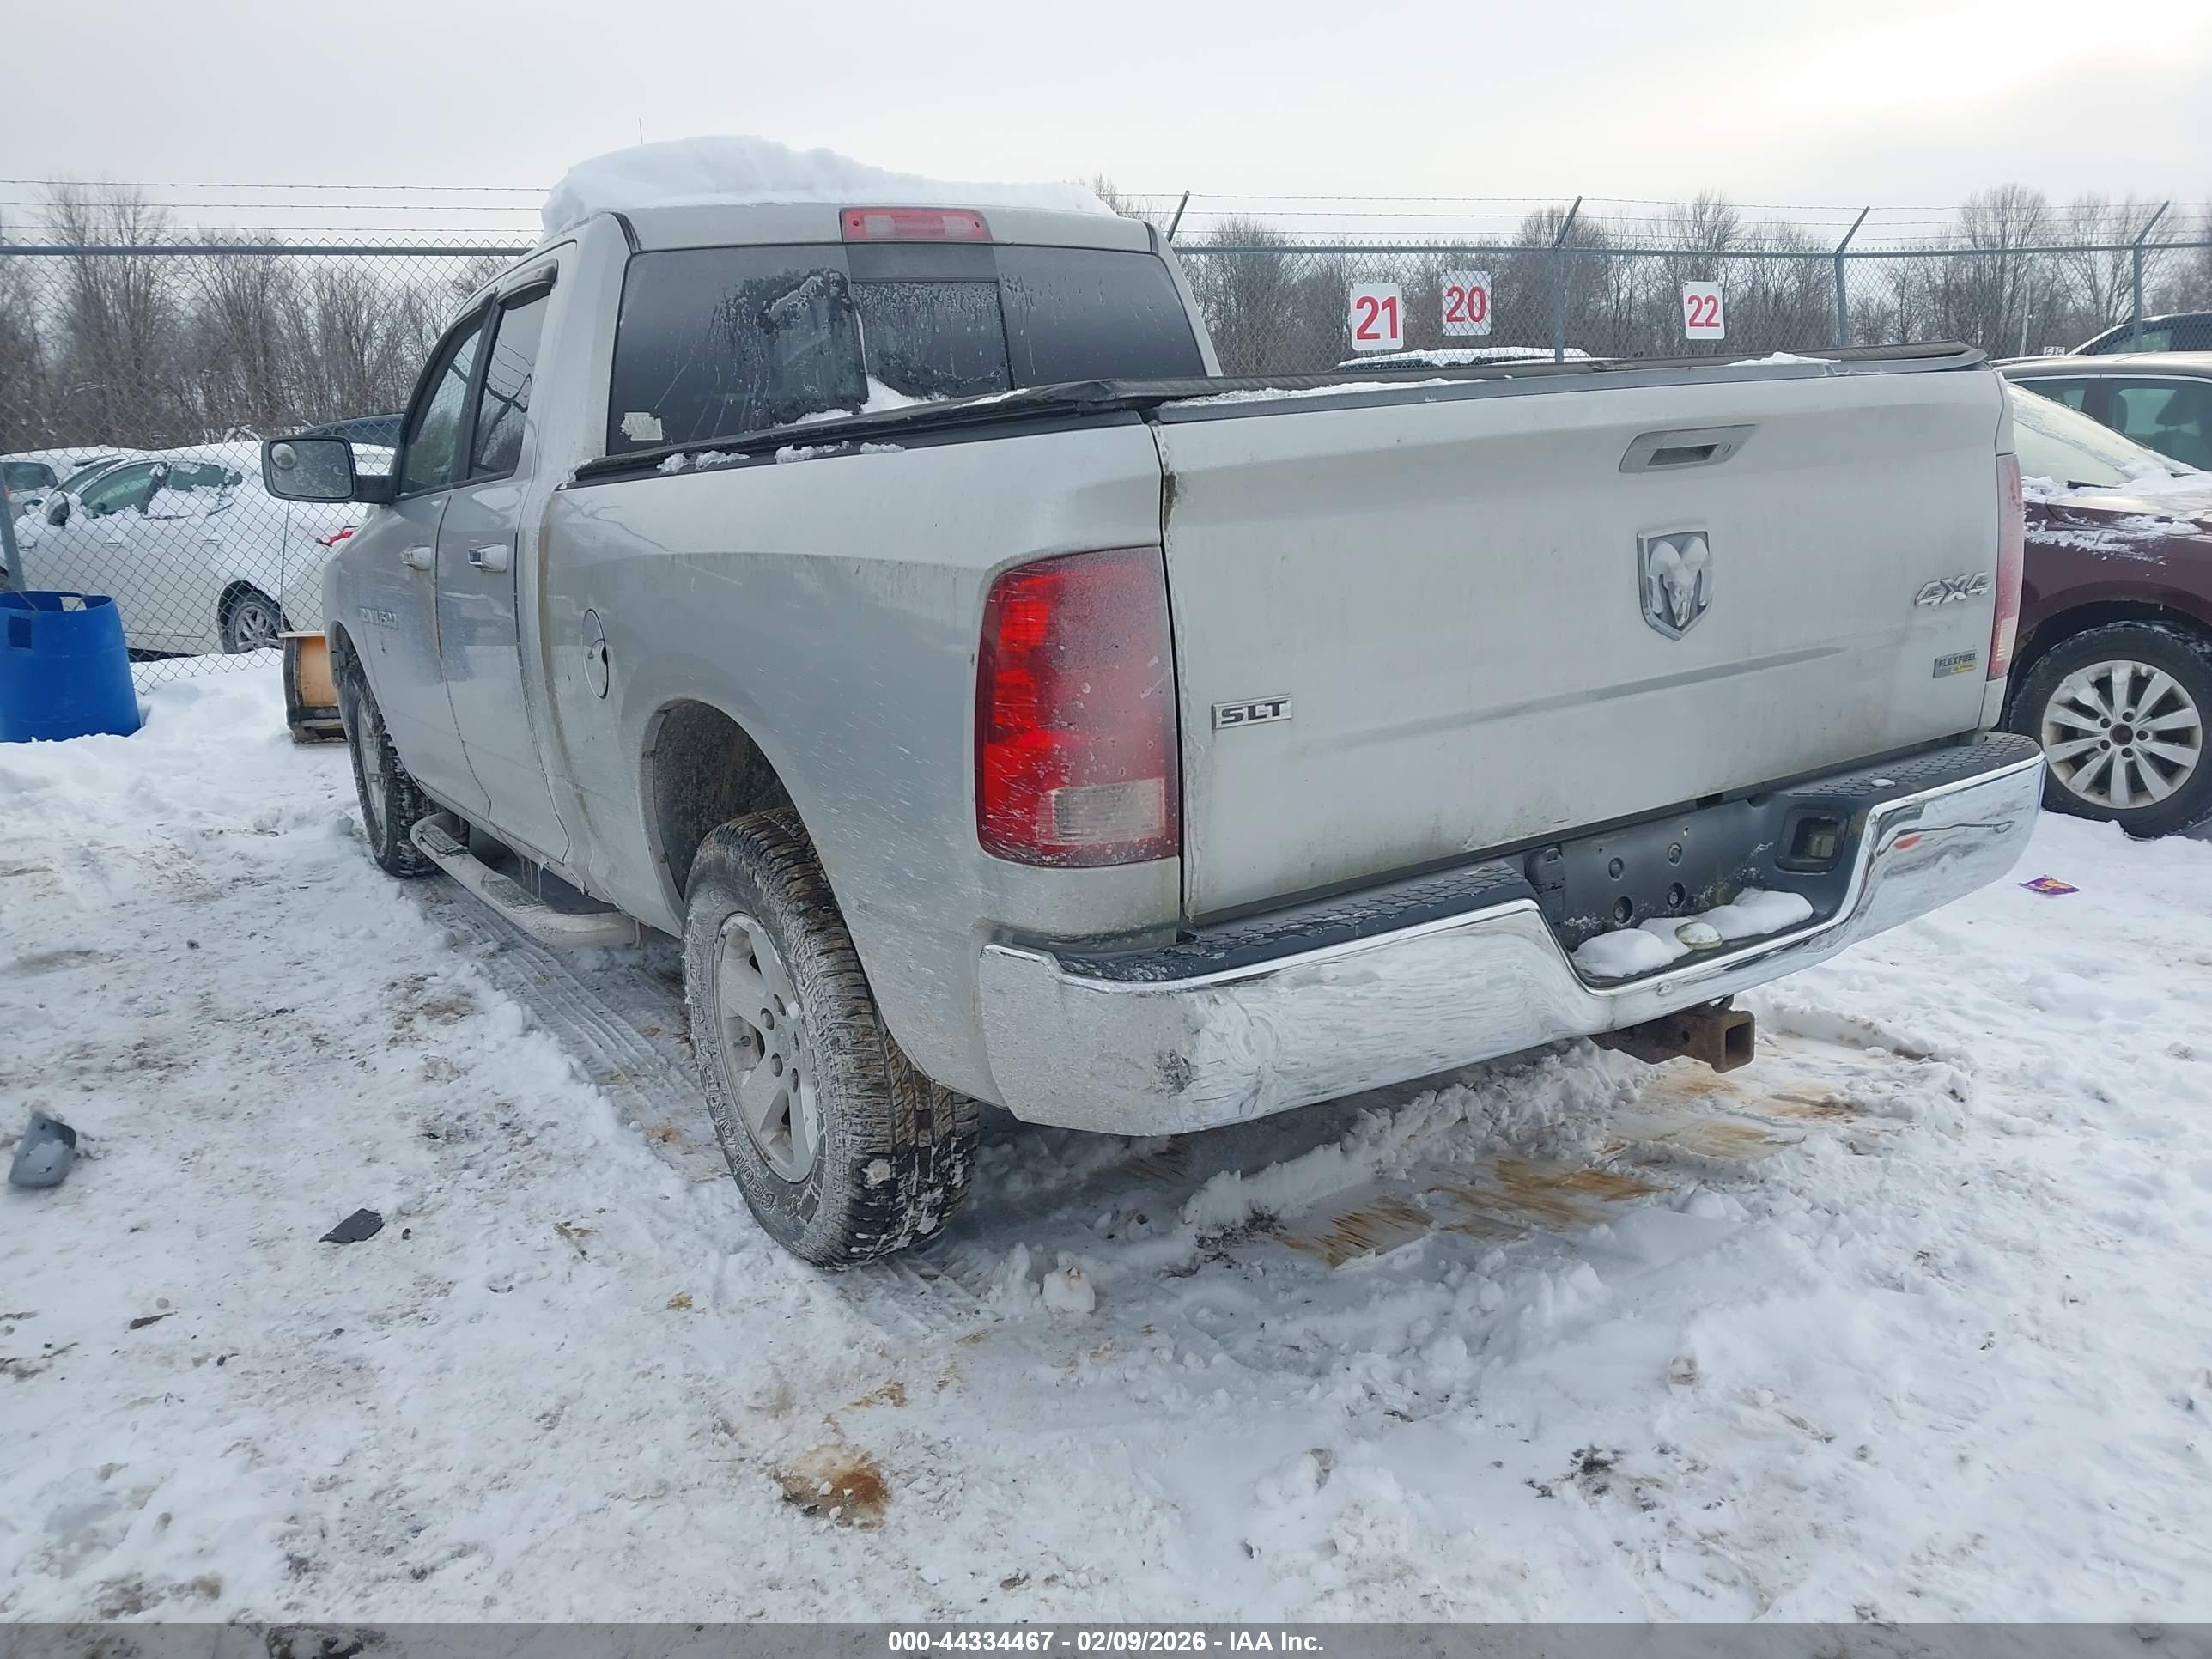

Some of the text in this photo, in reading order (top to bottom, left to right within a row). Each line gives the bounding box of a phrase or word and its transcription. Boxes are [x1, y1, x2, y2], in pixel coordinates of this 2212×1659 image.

[1355, 295, 1399, 340] 21
[1445, 285, 1487, 324] 20
[1687, 295, 1722, 328] 22
[1937, 653, 1978, 668] FLEXFUEL
[1221, 699, 1289, 726] SLT
